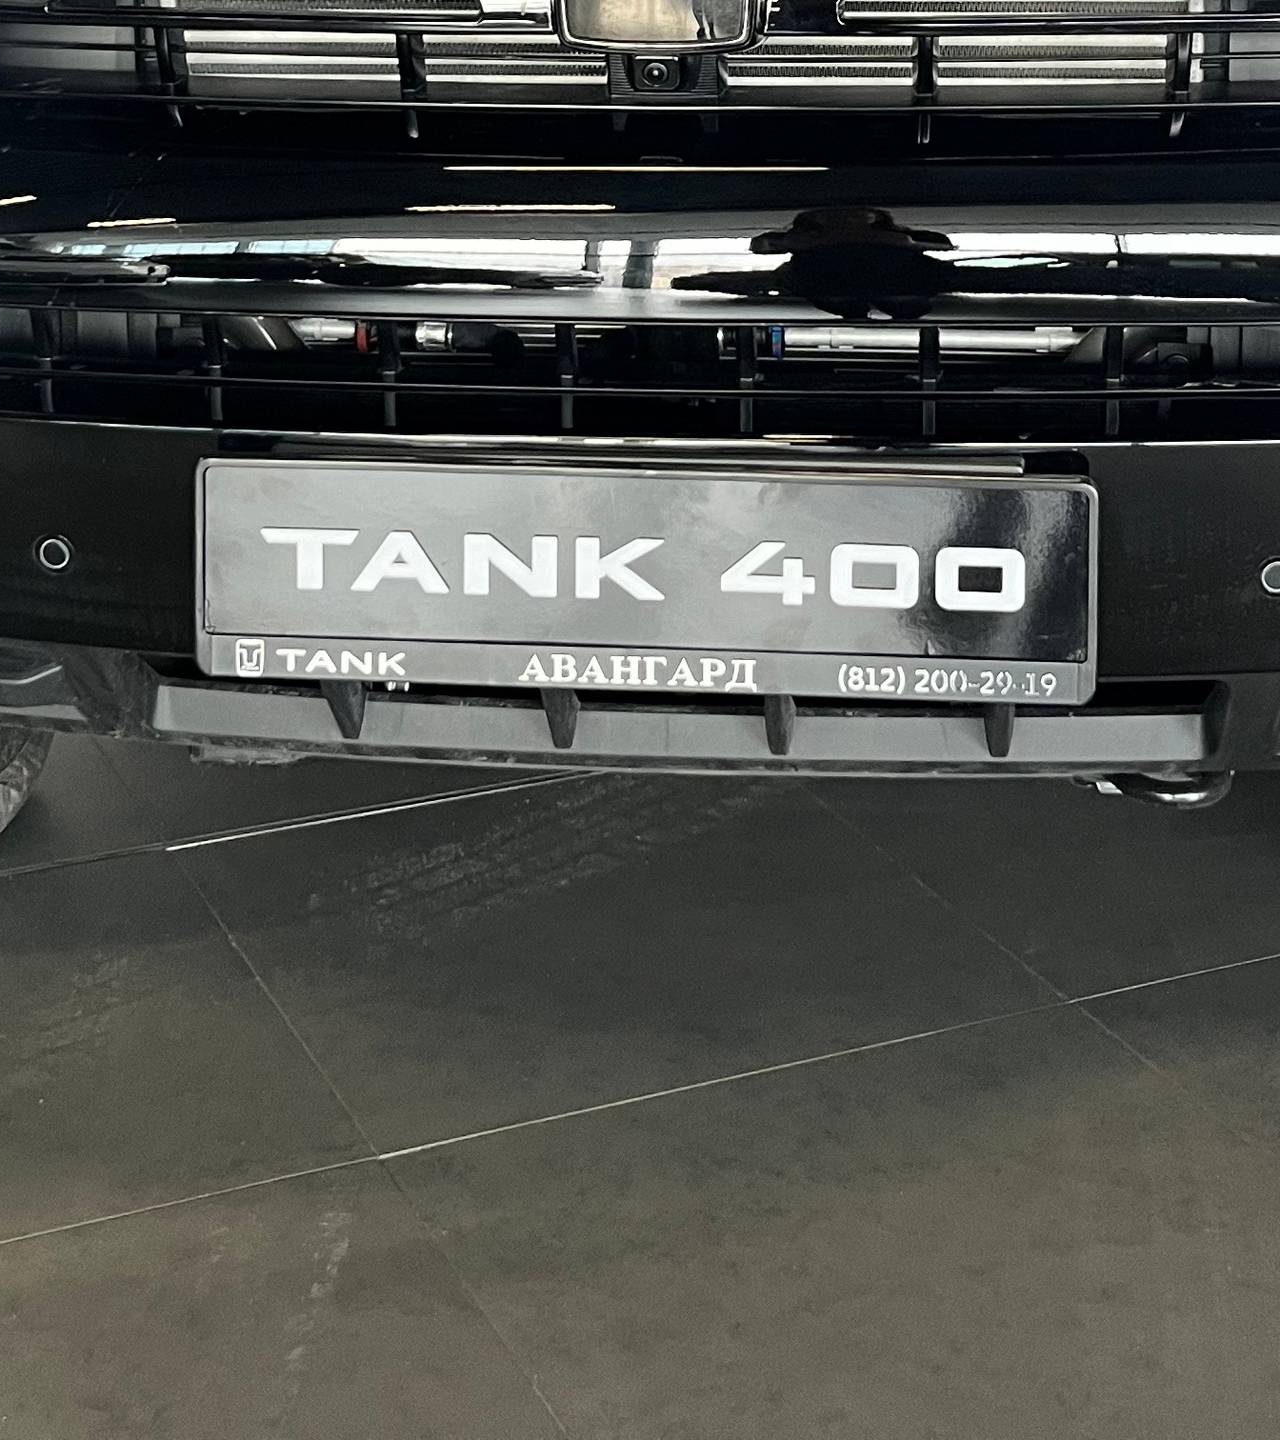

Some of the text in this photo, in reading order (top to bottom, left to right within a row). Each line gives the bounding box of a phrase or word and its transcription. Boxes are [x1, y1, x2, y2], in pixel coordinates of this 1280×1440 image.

[260, 525, 1026, 612] TANK 400
[275, 647, 407, 677] TANK
[517, 652, 760, 693] АВАНГАРД
[837, 663, 906, 695] (812)
